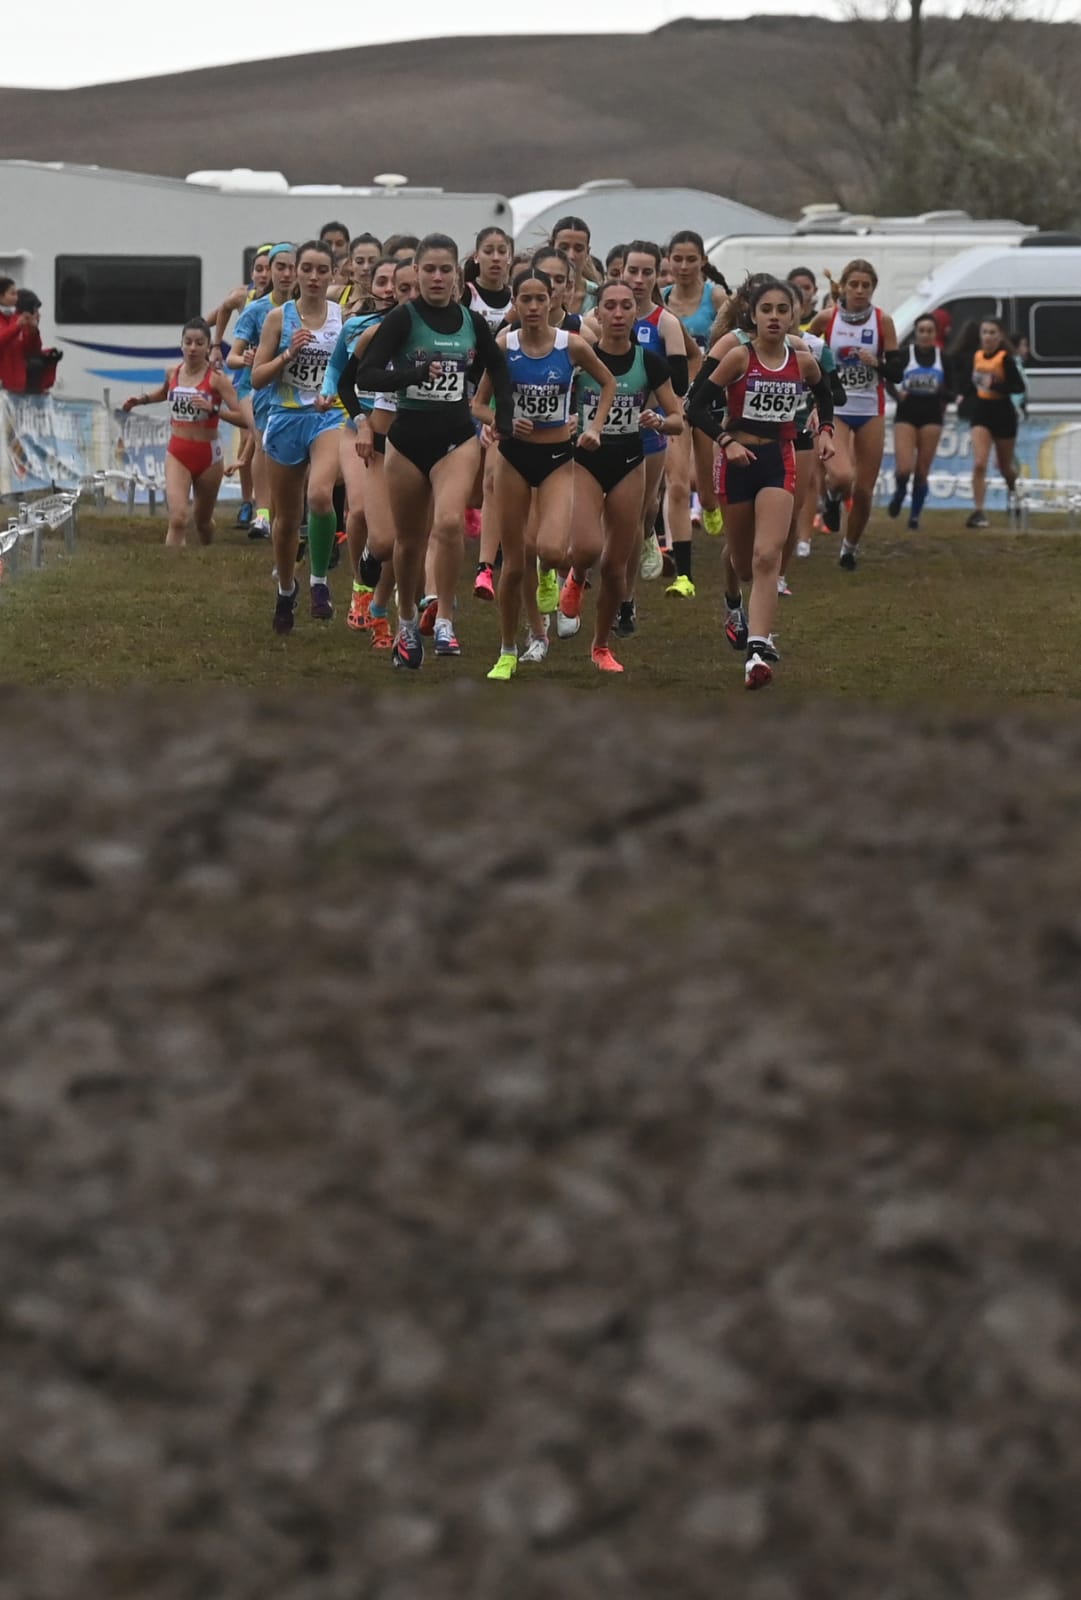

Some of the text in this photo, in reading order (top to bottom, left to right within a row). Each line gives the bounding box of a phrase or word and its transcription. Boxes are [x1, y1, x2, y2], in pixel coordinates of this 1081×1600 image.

[755, 381, 796, 390] DIPUTACIÓN
[517, 395, 559, 414] 4589
[749, 394, 796, 413] 4563
